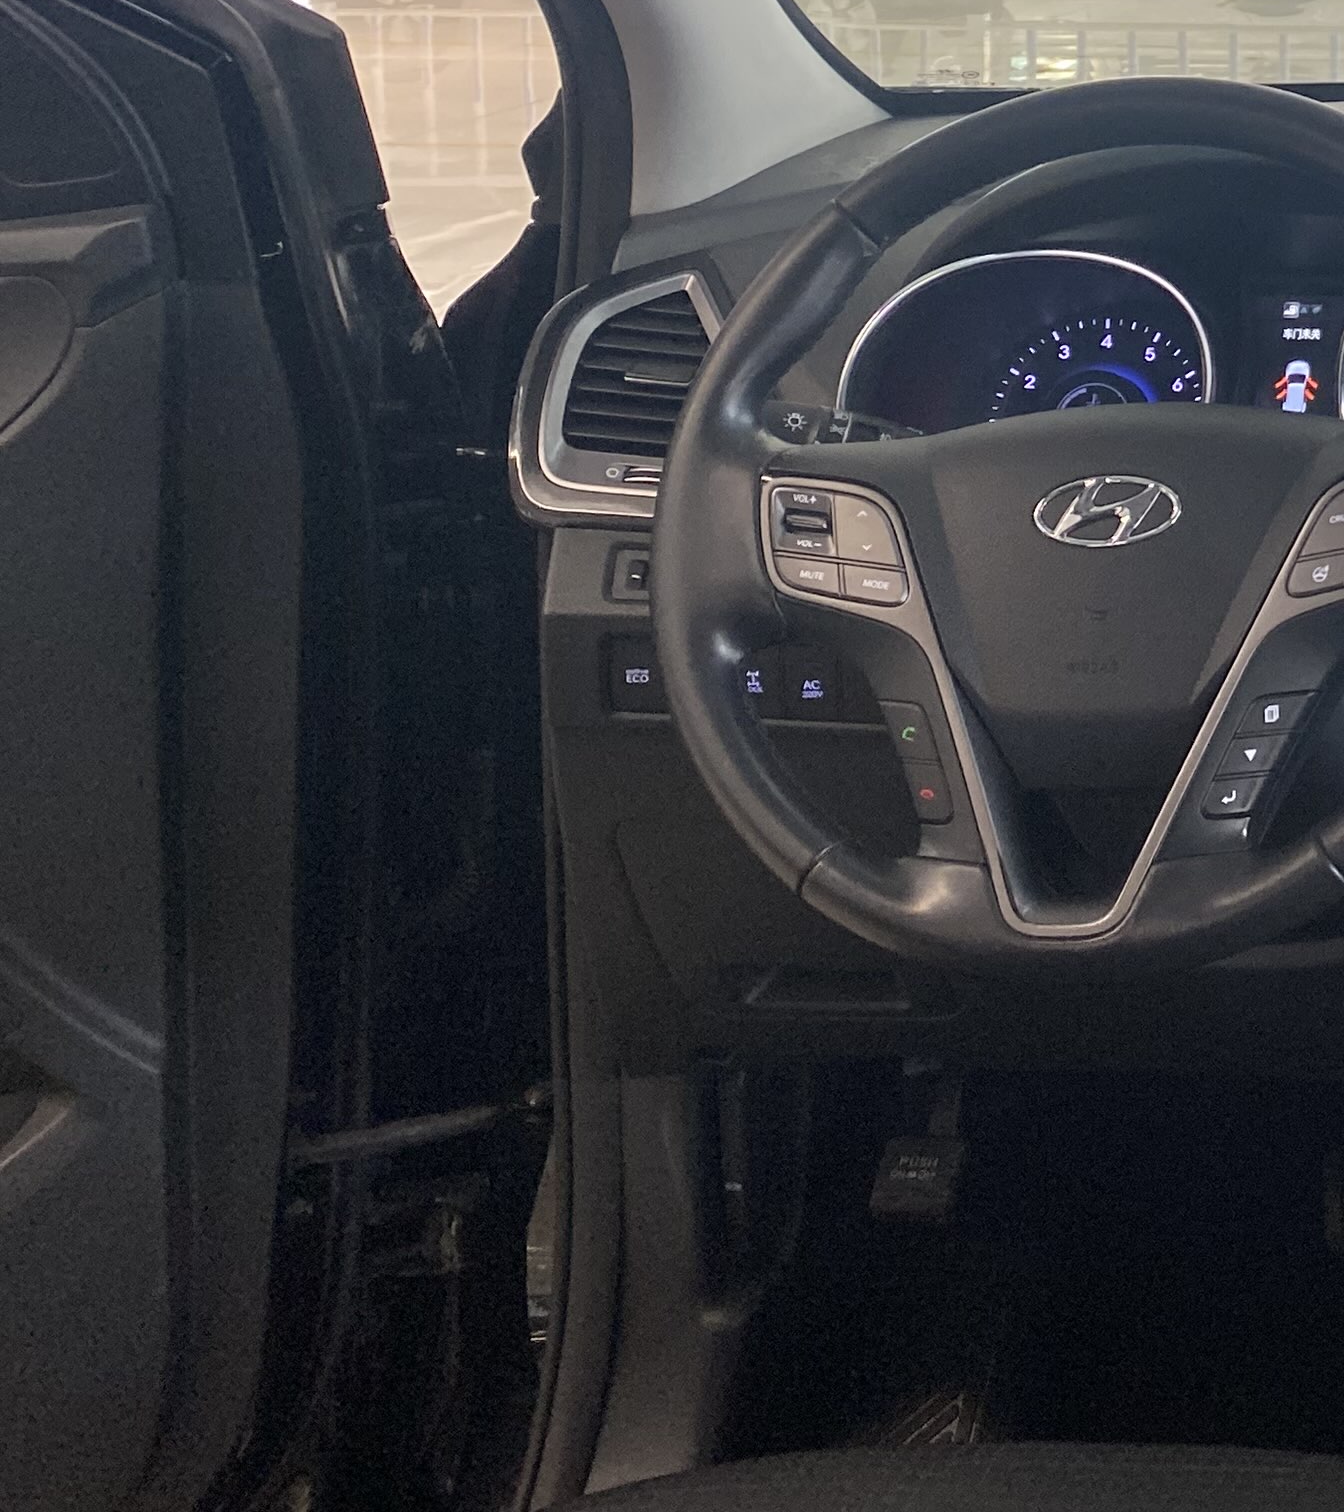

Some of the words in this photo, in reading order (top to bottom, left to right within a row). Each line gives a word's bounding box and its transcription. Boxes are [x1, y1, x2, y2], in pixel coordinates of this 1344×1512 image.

[1282, 328, 1321, 340] 车门未关
[1100, 334, 1113, 349] 4
[1058, 345, 1070, 360] 3
[1144, 347, 1156, 361] 5
[1023, 375, 1036, 389] 2
[1171, 378, 1184, 392] 6
[800, 570, 824, 580] MUTE
[862, 579, 890, 590] MODE
[626, 674, 649, 683] ECO
[803, 680, 821, 689] AC
